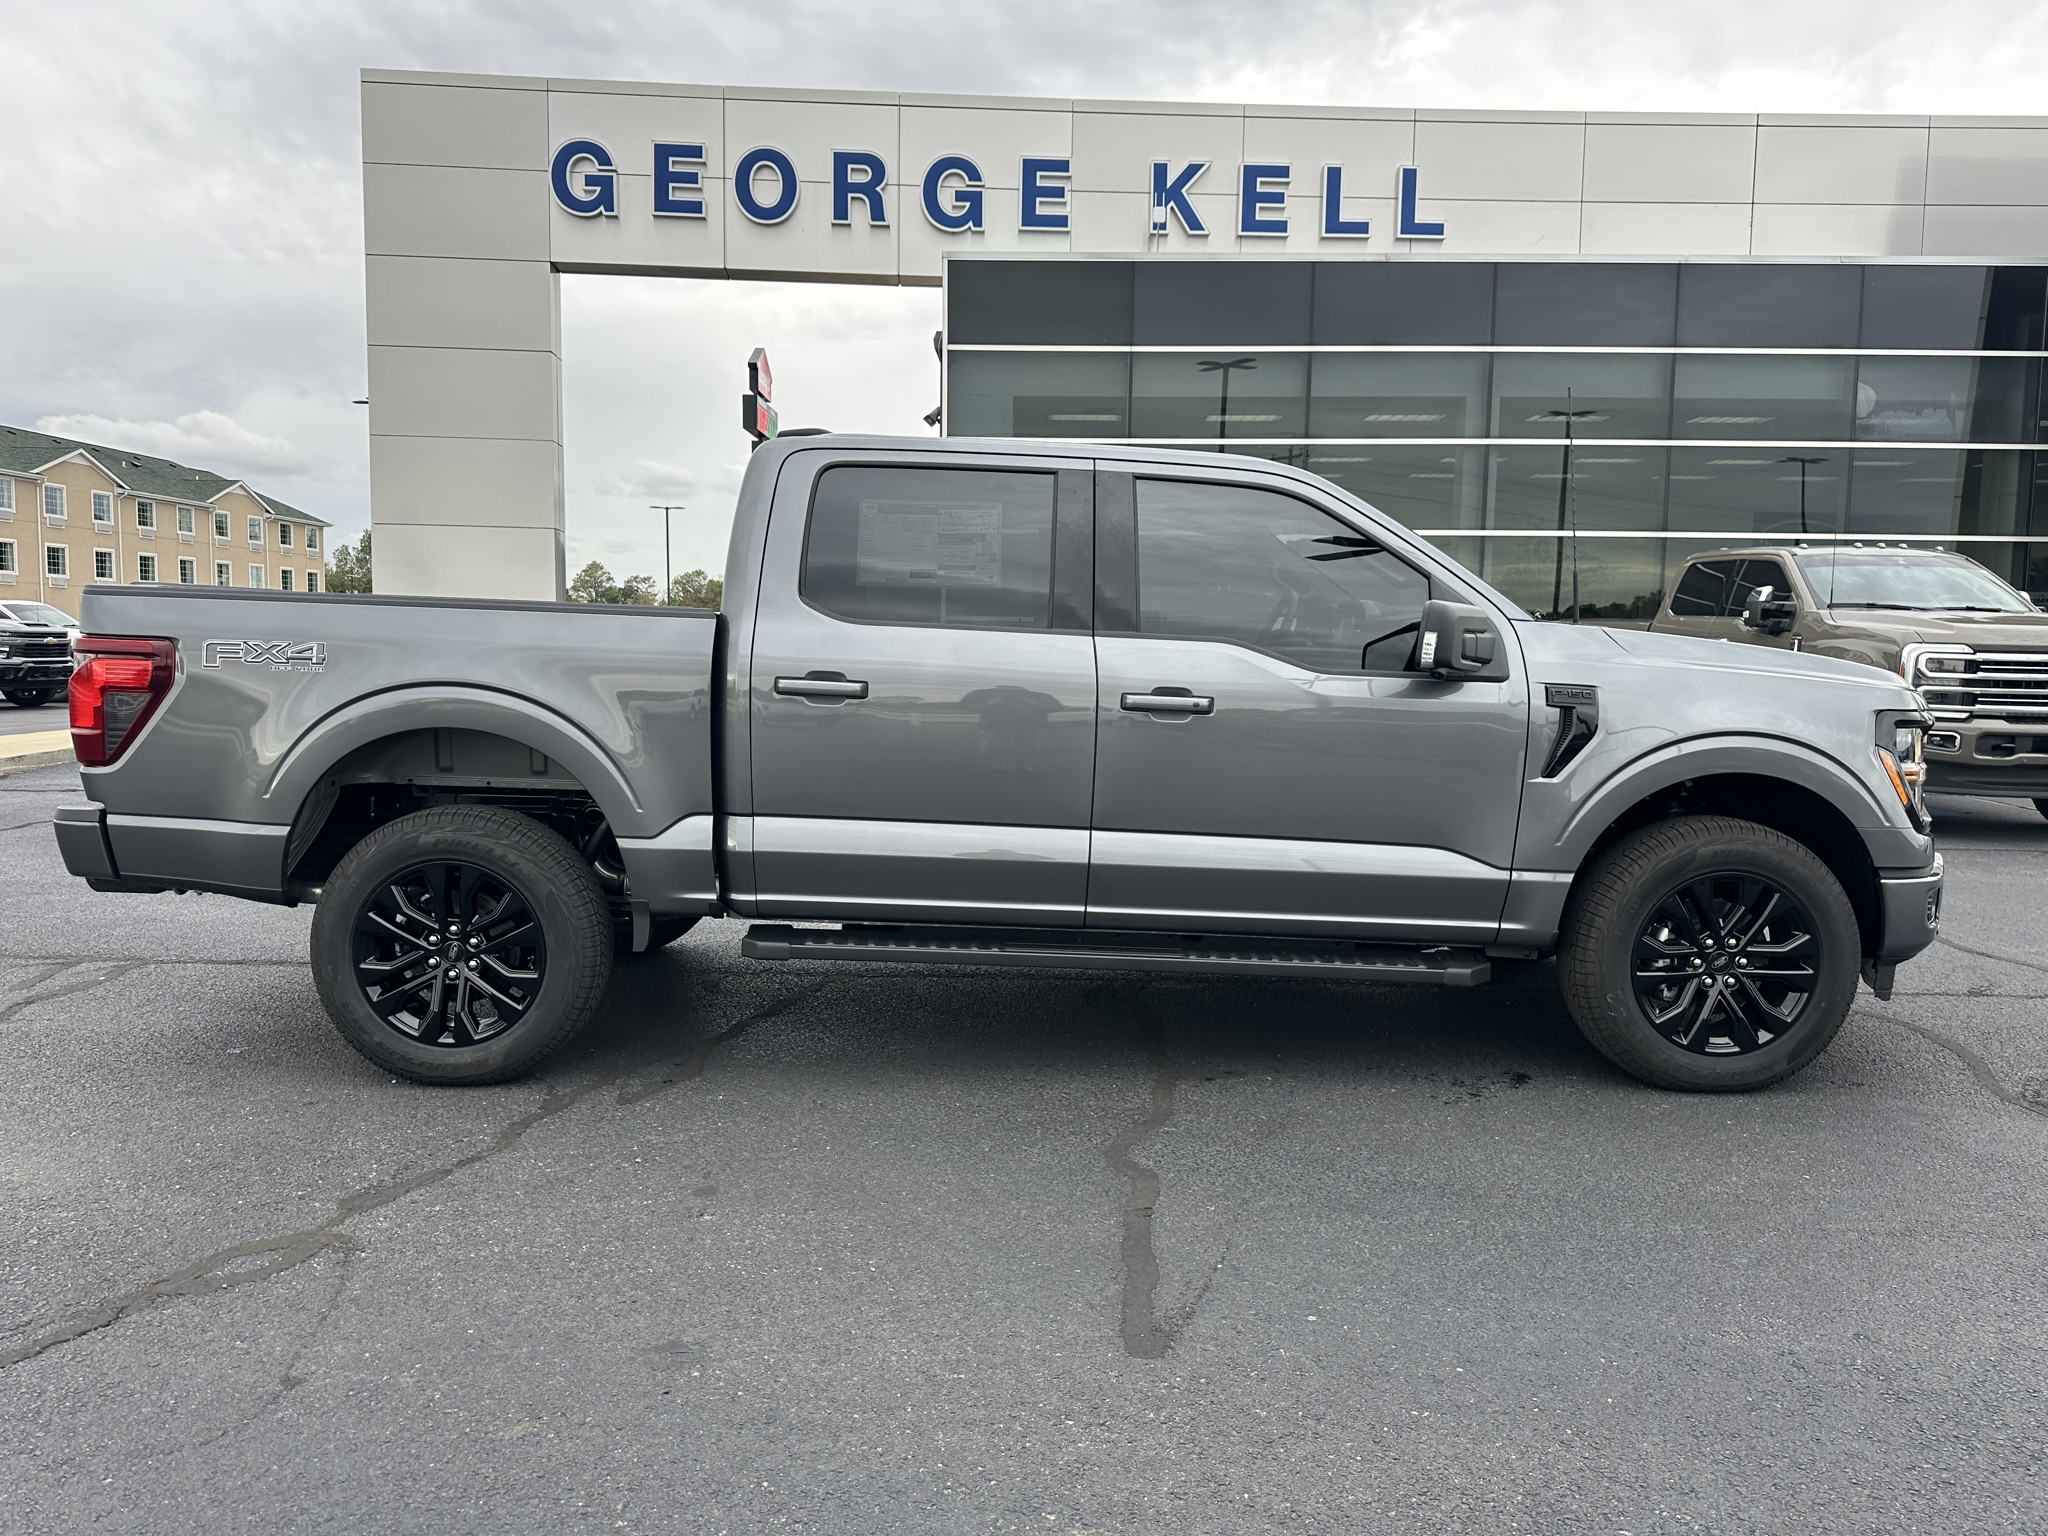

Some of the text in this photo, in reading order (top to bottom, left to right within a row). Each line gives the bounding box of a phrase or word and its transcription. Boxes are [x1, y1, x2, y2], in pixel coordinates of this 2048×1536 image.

[549, 138, 1446, 241] GEORGE KELL
[202, 639, 328, 669] FX4
[1551, 690, 1593, 699] F-150
